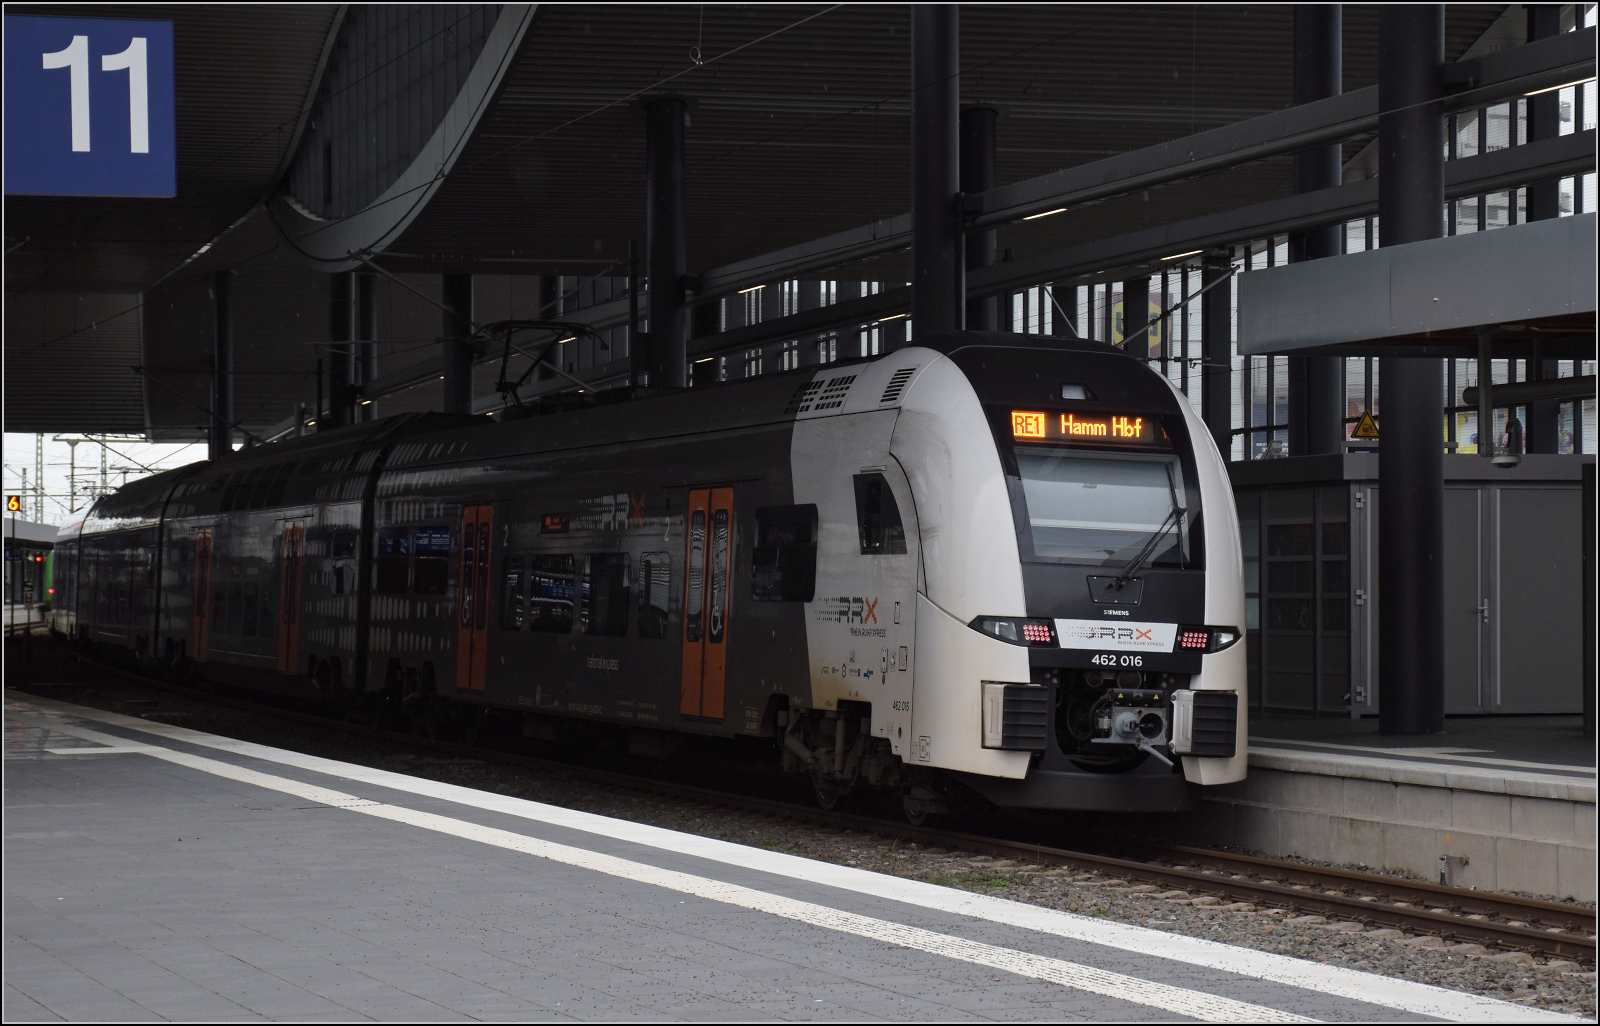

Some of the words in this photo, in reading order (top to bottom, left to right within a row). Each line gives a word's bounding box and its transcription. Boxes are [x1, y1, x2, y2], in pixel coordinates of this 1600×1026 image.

[43, 35, 148, 153] 11
[1014, 415, 1040, 435] RE1
[1061, 413, 1107, 436] Hamm
[1112, 415, 1142, 438] Hbf
[8, 496, 19, 511] 6
[502, 524, 508, 547] 2
[664, 516, 670, 542] 2
[838, 596, 878, 625] RRX
[850, 627, 861, 637] RHEIN
[1099, 626, 1153, 641] RRX
[1091, 654, 1117, 666] 462
[1120, 655, 1143, 667] 016
[893, 700, 901, 711] 462
